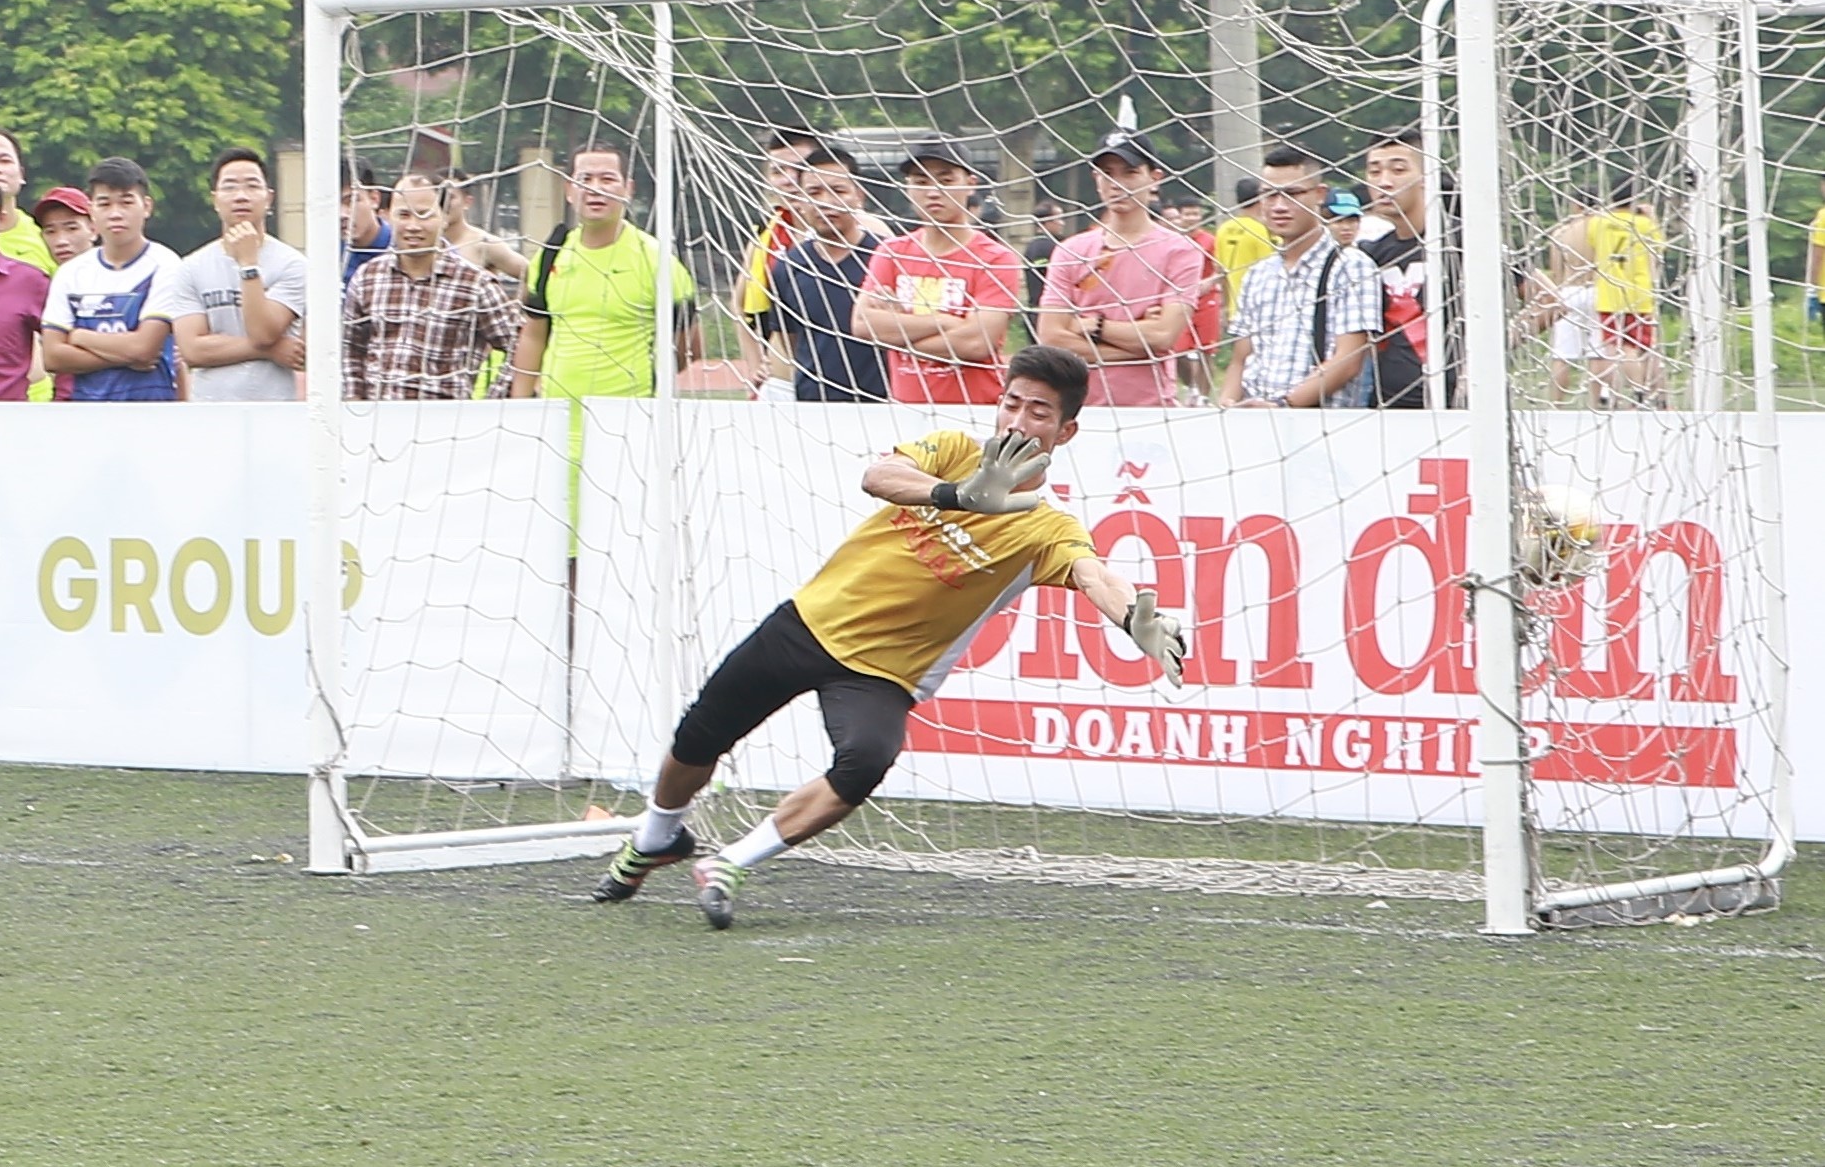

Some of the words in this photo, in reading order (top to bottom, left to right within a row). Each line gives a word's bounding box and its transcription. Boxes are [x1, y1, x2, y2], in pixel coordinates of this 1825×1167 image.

[880, 452, 1313, 690] iễn
[1031, 706, 1248, 763] DOANH
[1284, 718, 1552, 780] NGHIP
